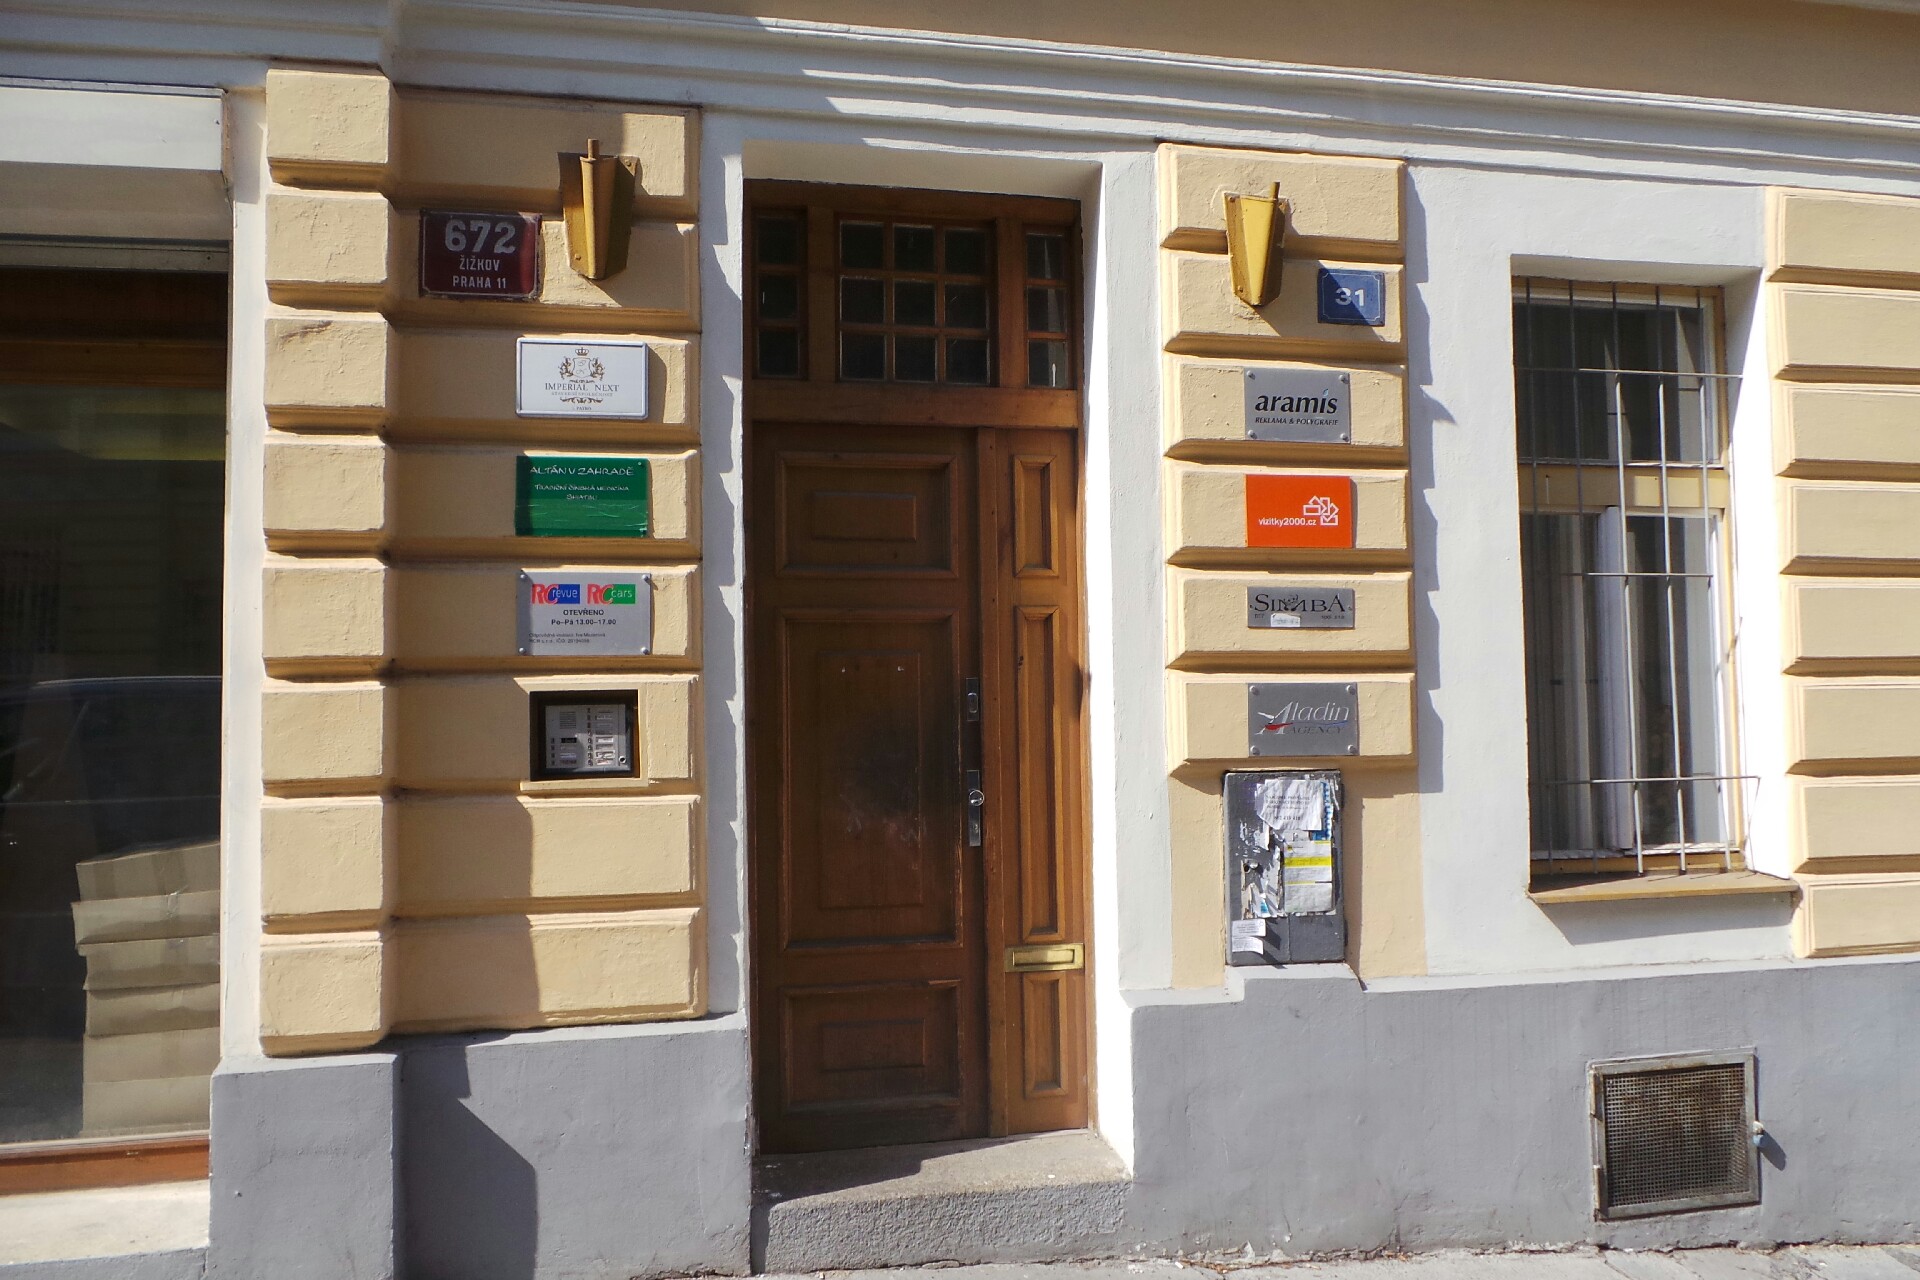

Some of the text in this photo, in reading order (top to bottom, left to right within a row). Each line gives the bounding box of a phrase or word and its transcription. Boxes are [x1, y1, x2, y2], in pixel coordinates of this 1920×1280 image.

[444, 220, 516, 254] 672
[459, 255, 500, 271] ŽIŽKOV
[452, 275, 507, 289] PRAHA 11
[1335, 287, 1365, 307] 31
[545, 382, 620, 392] IMPERIAL NEXT
[1255, 388, 1338, 414] aramis
[1255, 416, 1287, 425] REKLAMA
[1296, 418, 1339, 426] POLYGRAFIE
[530, 465, 567, 475] ALTÁN
[578, 466, 635, 476] ZAHRADĚ
[1258, 517, 1317, 528] vizitky2000.cz
[610, 589, 633, 599] cars
[1254, 593, 1345, 612] SIMBA
[563, 608, 605, 616] OTEVŘENO
[1254, 701, 1350, 735] Aladin
